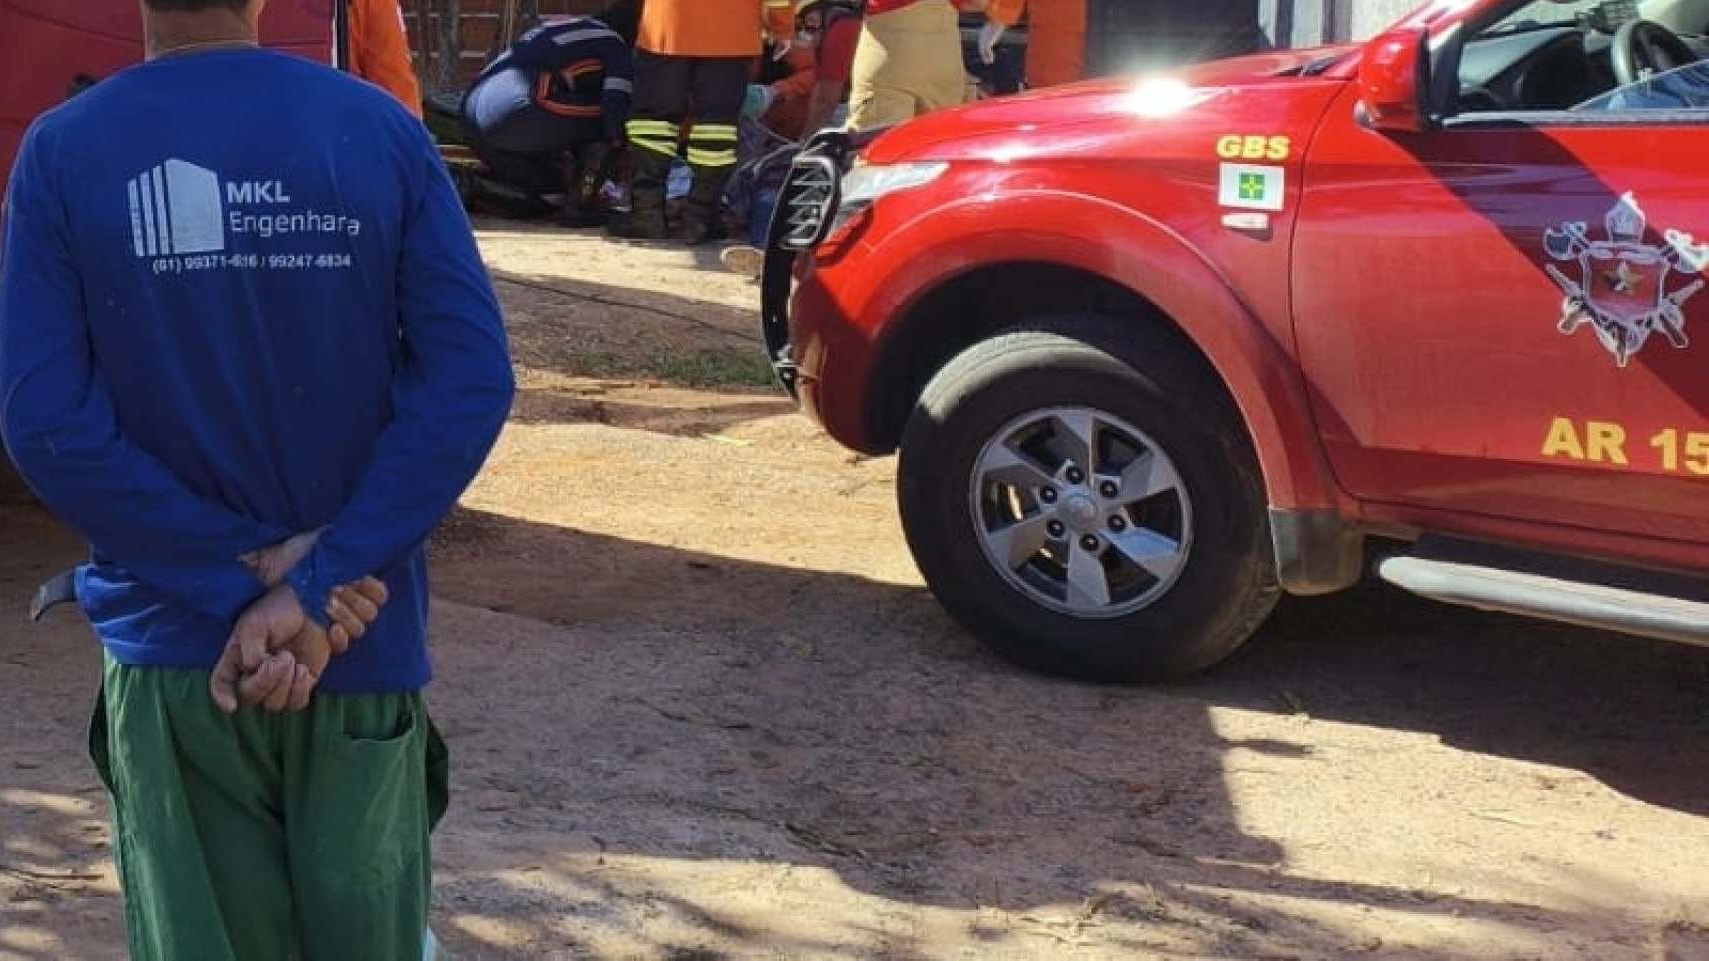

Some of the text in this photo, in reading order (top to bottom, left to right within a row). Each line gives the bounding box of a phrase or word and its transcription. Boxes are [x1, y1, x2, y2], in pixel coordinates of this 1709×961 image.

[1216, 134, 1290, 159] GBS
[226, 181, 290, 204] MKL
[1540, 416, 1629, 465] AR
